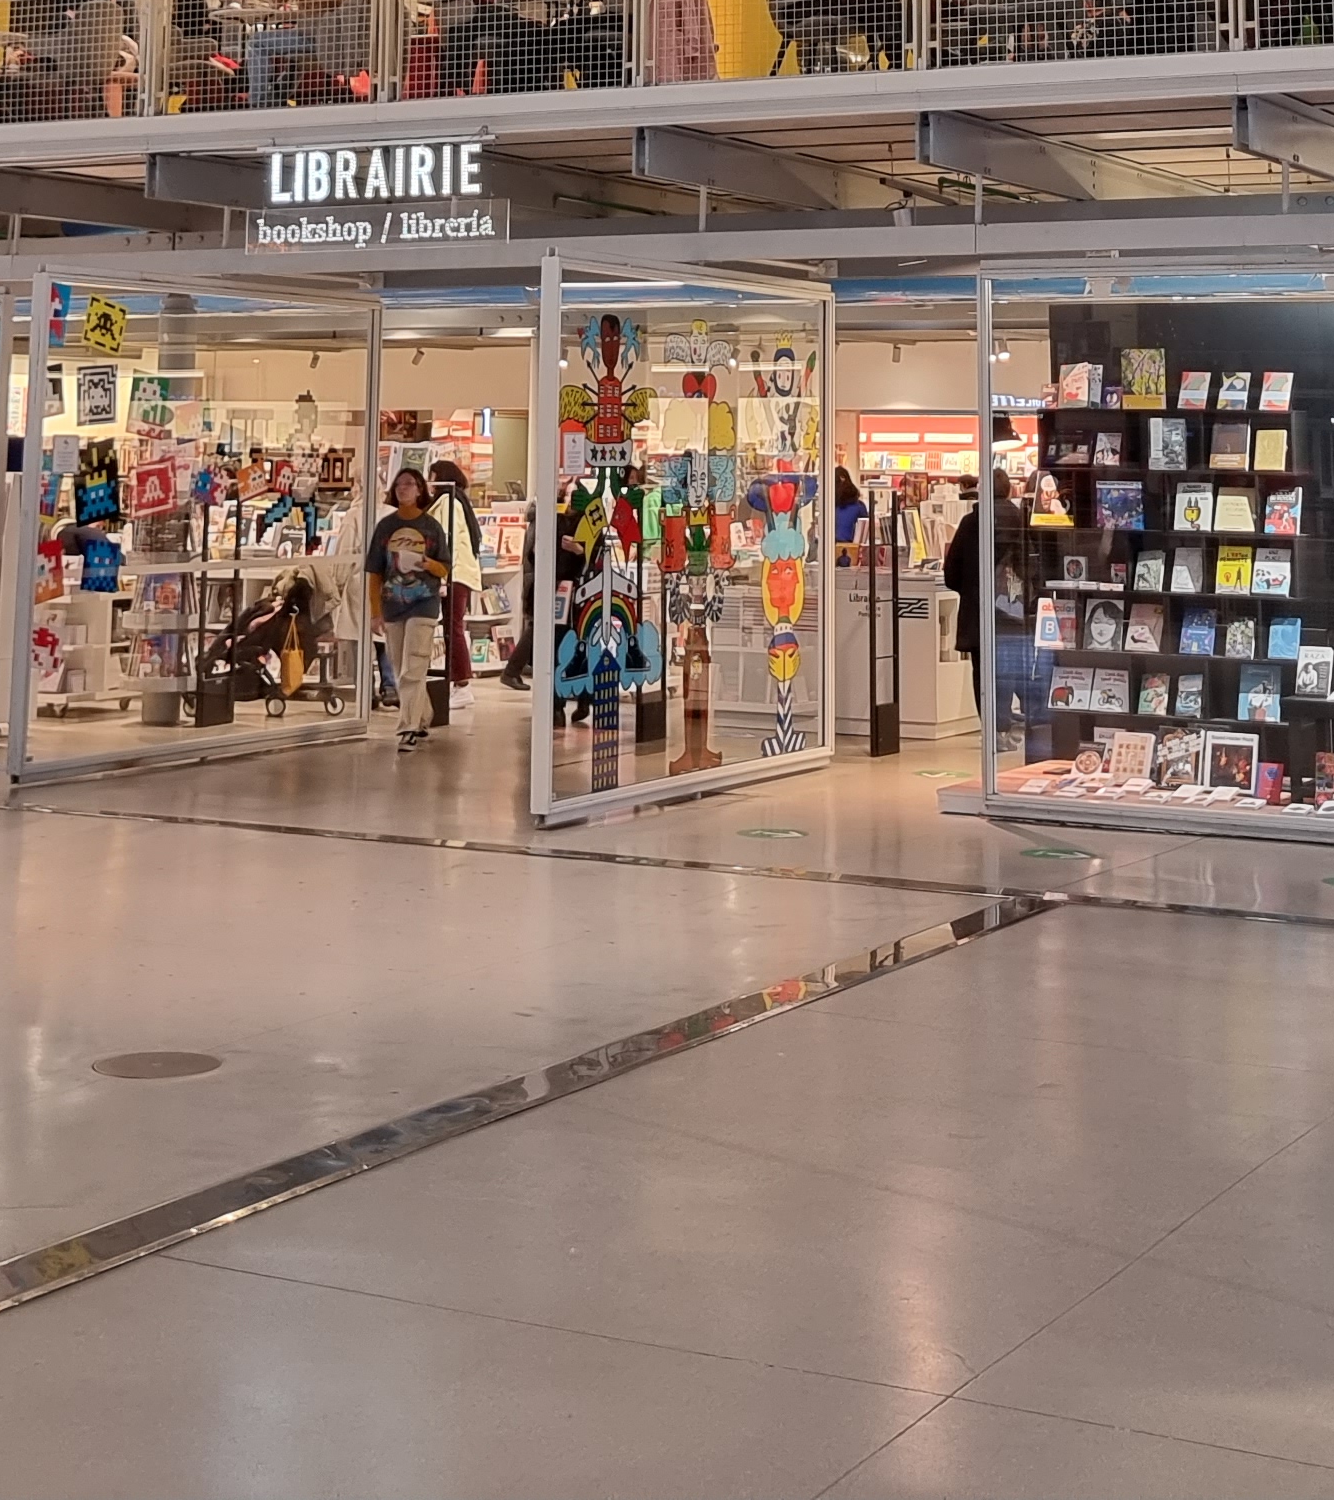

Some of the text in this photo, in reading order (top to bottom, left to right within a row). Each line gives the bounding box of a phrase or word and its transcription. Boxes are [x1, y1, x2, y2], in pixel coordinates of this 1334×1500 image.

[270, 143, 483, 204] LIBRAIRIE
[256, 215, 373, 248] bookshop
[399, 209, 496, 239] librería
[1045, 621, 1055, 634] B
